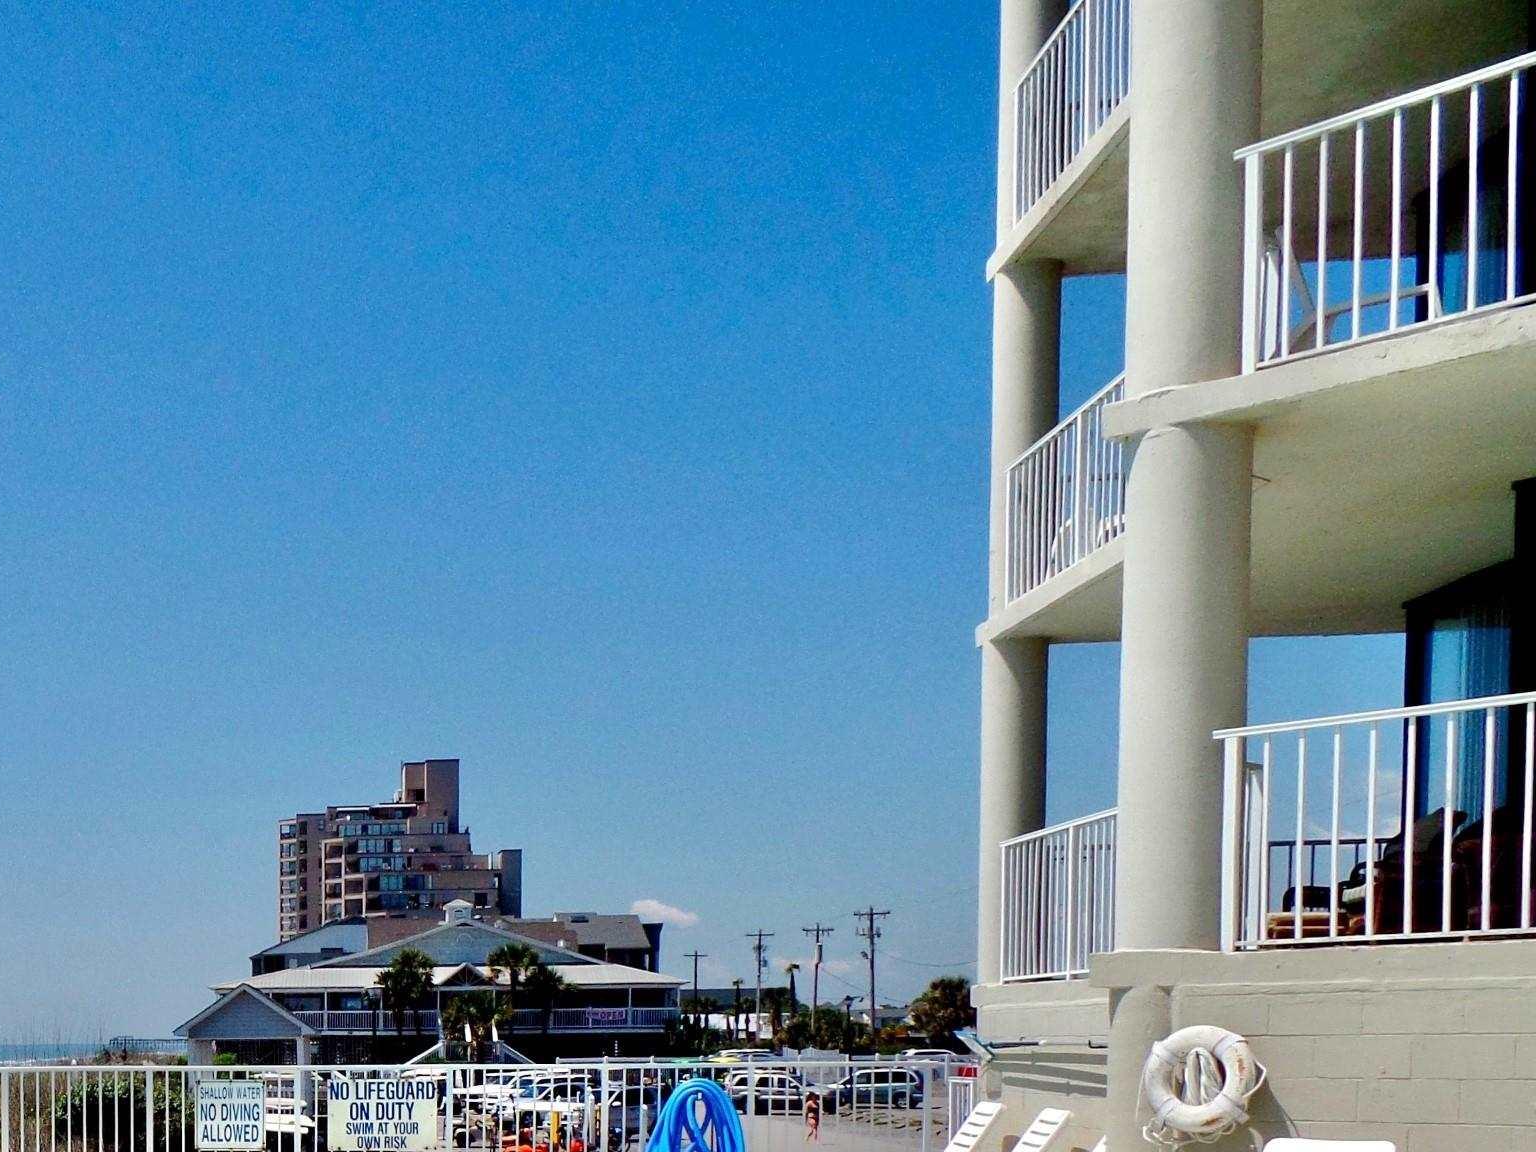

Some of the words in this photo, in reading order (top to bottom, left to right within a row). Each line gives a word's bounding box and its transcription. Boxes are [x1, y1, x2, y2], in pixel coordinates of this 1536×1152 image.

[200, 1087, 233, 1099] SHALLOW
[236, 1087, 261, 1099] WATER
[330, 1081, 350, 1100] NO
[355, 1081, 436, 1100] LIFEGUARD
[200, 1103, 216, 1121] NO
[221, 1103, 260, 1121] DIVING
[350, 1102, 370, 1120] ON
[376, 1102, 415, 1120] DUTY
[201, 1124, 259, 1142] ALLOWED
[346, 1122, 374, 1135] SWIM
[377, 1122, 389, 1135] AT
[393, 1122, 419, 1135] YOUR
[357, 1136, 381, 1149] OWN
[384, 1136, 407, 1149] RISK
